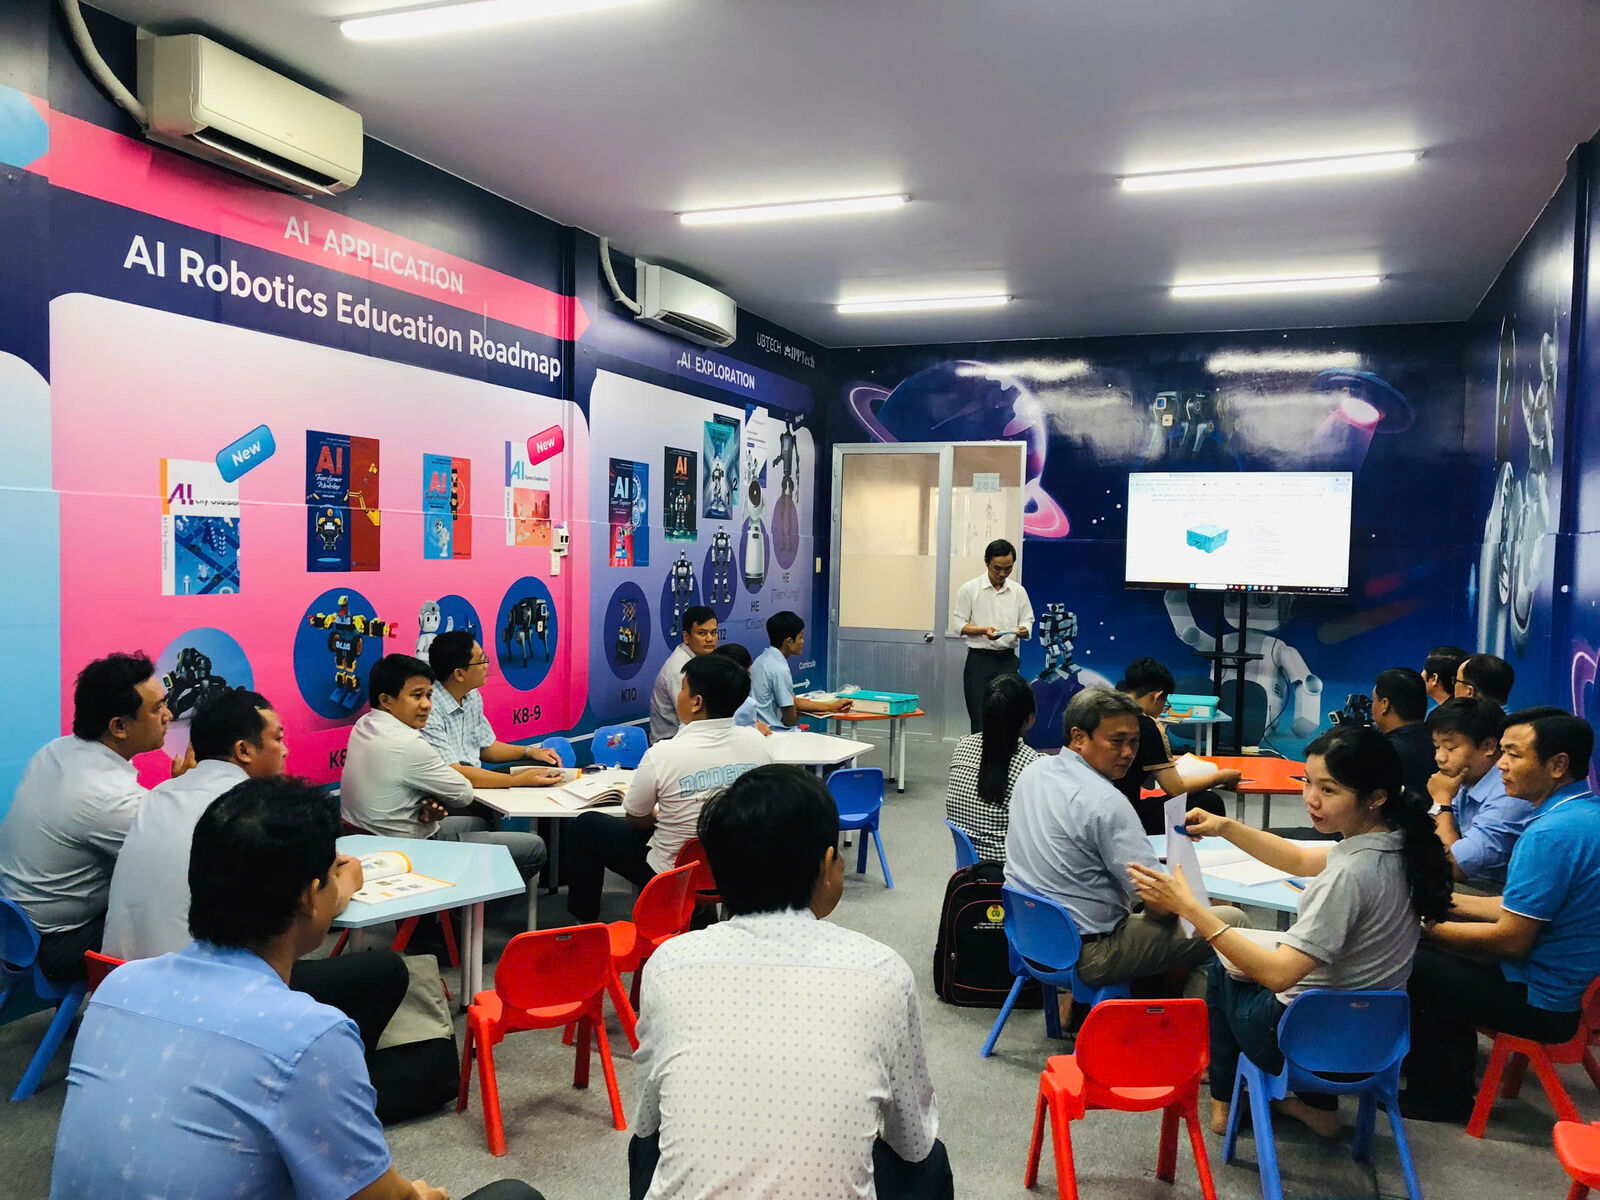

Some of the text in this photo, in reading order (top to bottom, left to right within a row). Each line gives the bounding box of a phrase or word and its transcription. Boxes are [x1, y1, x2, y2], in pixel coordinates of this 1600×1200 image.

[284, 215, 465, 295] AI APPLICATION
[123, 234, 562, 383] AI Robotics Education Roadmap
[756, 332, 782, 354] UBTECH
[681, 352, 756, 390] AI EXPLORATION
[231, 440, 262, 467] New
[536, 437, 556, 455] New
[315, 445, 343, 475] AI
[511, 460, 525, 480] AI
[675, 455, 688, 475] AI
[428, 471, 447, 494] AI
[613, 476, 630, 499] AI
[167, 483, 195, 506] AI
[750, 600, 760, 612] HE
[620, 687, 638, 705] K10
[512, 704, 542, 725] K8-9
[329, 748, 348, 769] K8
[680, 763, 758, 798] DODGE
